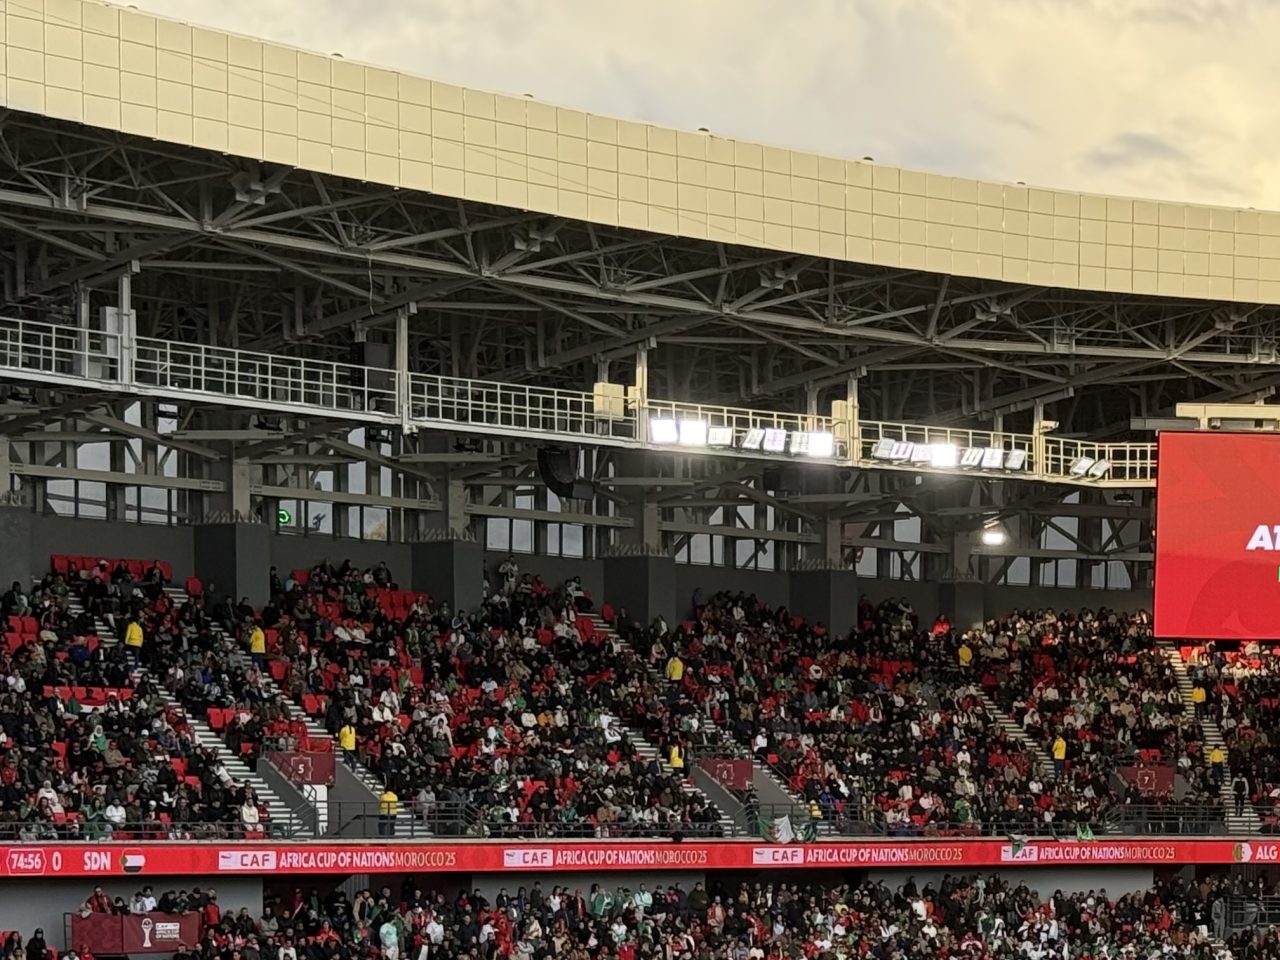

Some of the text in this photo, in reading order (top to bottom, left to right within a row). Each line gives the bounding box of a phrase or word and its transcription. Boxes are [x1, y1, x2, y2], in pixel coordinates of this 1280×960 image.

[297, 764, 305, 774] 5
[1143, 776, 1149, 784] 7
[240, 852, 456, 868] CAF AFRICA CUP OF NATIONS MOROCCO 25
[522, 850, 707, 865] CAF AFRICA CUP OF NATIONS MOROCCO 25
[772, 848, 962, 863] CAF AFRICA CUP OF NATIONS MOROCCO 25
[1039, 847, 1064, 859] AFRICA
[1064, 847, 1080, 859] CUP
[1080, 847, 1092, 859] OF
[1092, 847, 1124, 859] NATIONS
[1124, 847, 1165, 859] MOROCCO
[1165, 847, 1175, 859] 25
[1255, 845, 1278, 860] ALG
[11, 851, 111, 871] 74:56 0 SDN
